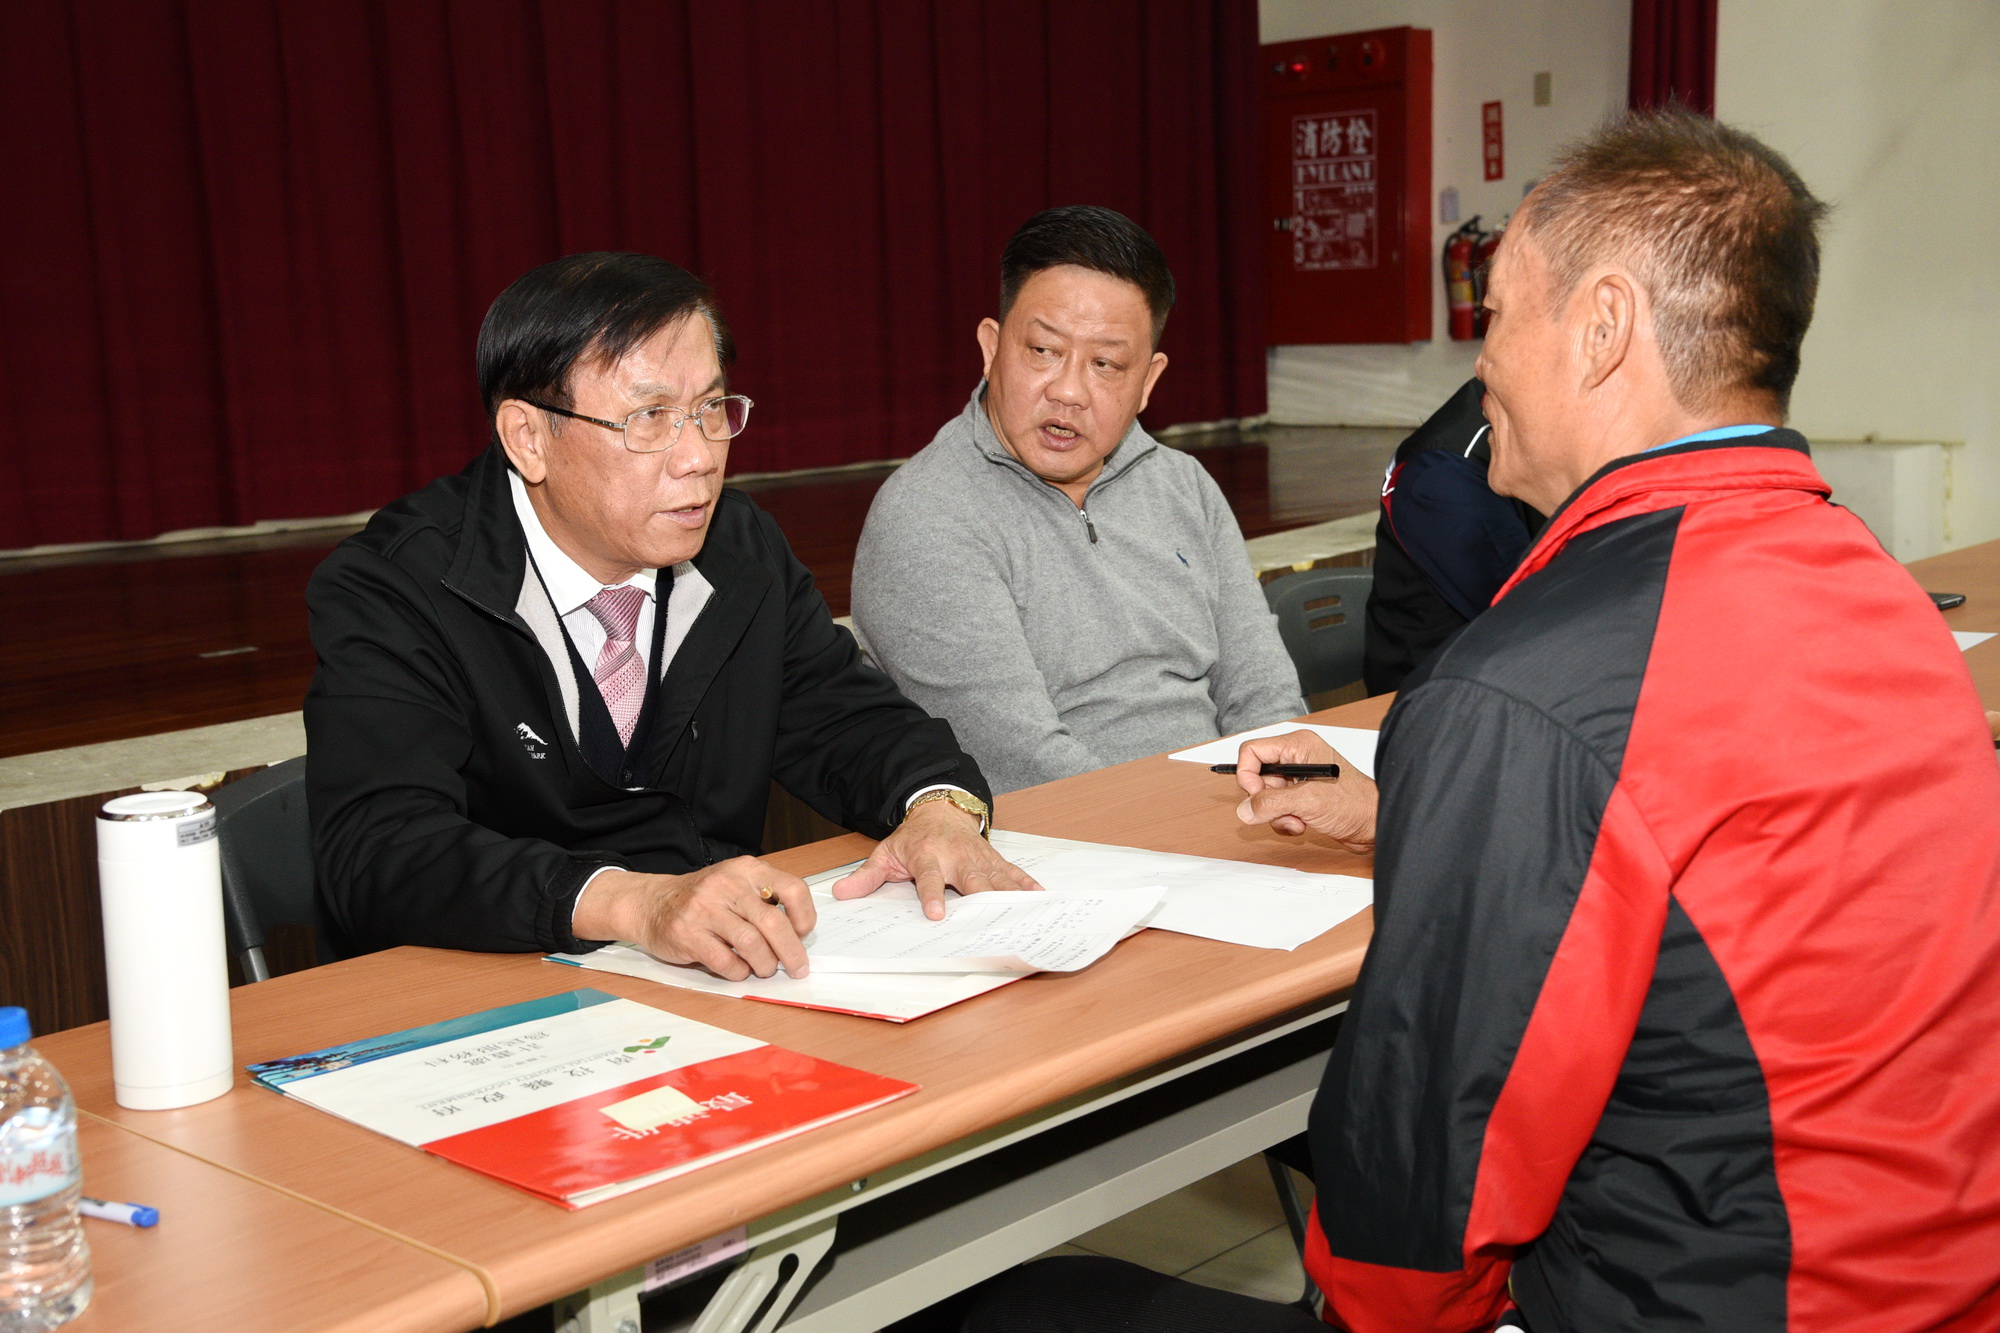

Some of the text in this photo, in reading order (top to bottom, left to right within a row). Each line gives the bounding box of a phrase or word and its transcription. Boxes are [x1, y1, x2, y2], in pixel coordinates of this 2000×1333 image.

[1295, 118, 1372, 158] 消防栓
[431, 1054, 635, 1117] 南投縣政府
